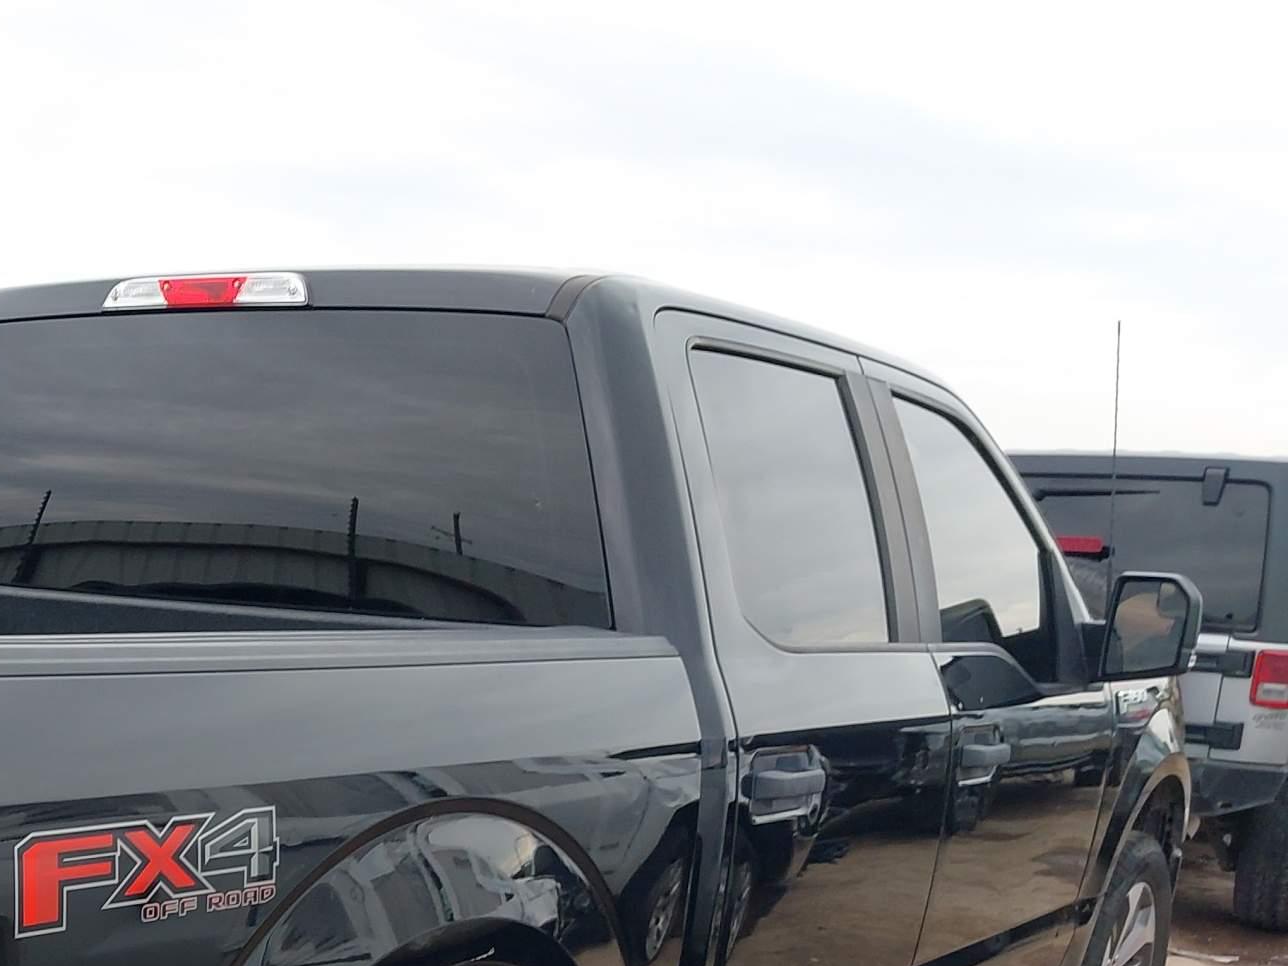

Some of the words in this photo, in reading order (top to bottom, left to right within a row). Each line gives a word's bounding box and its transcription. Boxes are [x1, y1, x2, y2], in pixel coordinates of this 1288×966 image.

[14, 805, 279, 939] FX4
[141, 896, 198, 923] OFF
[206, 884, 277, 913] ROAD
